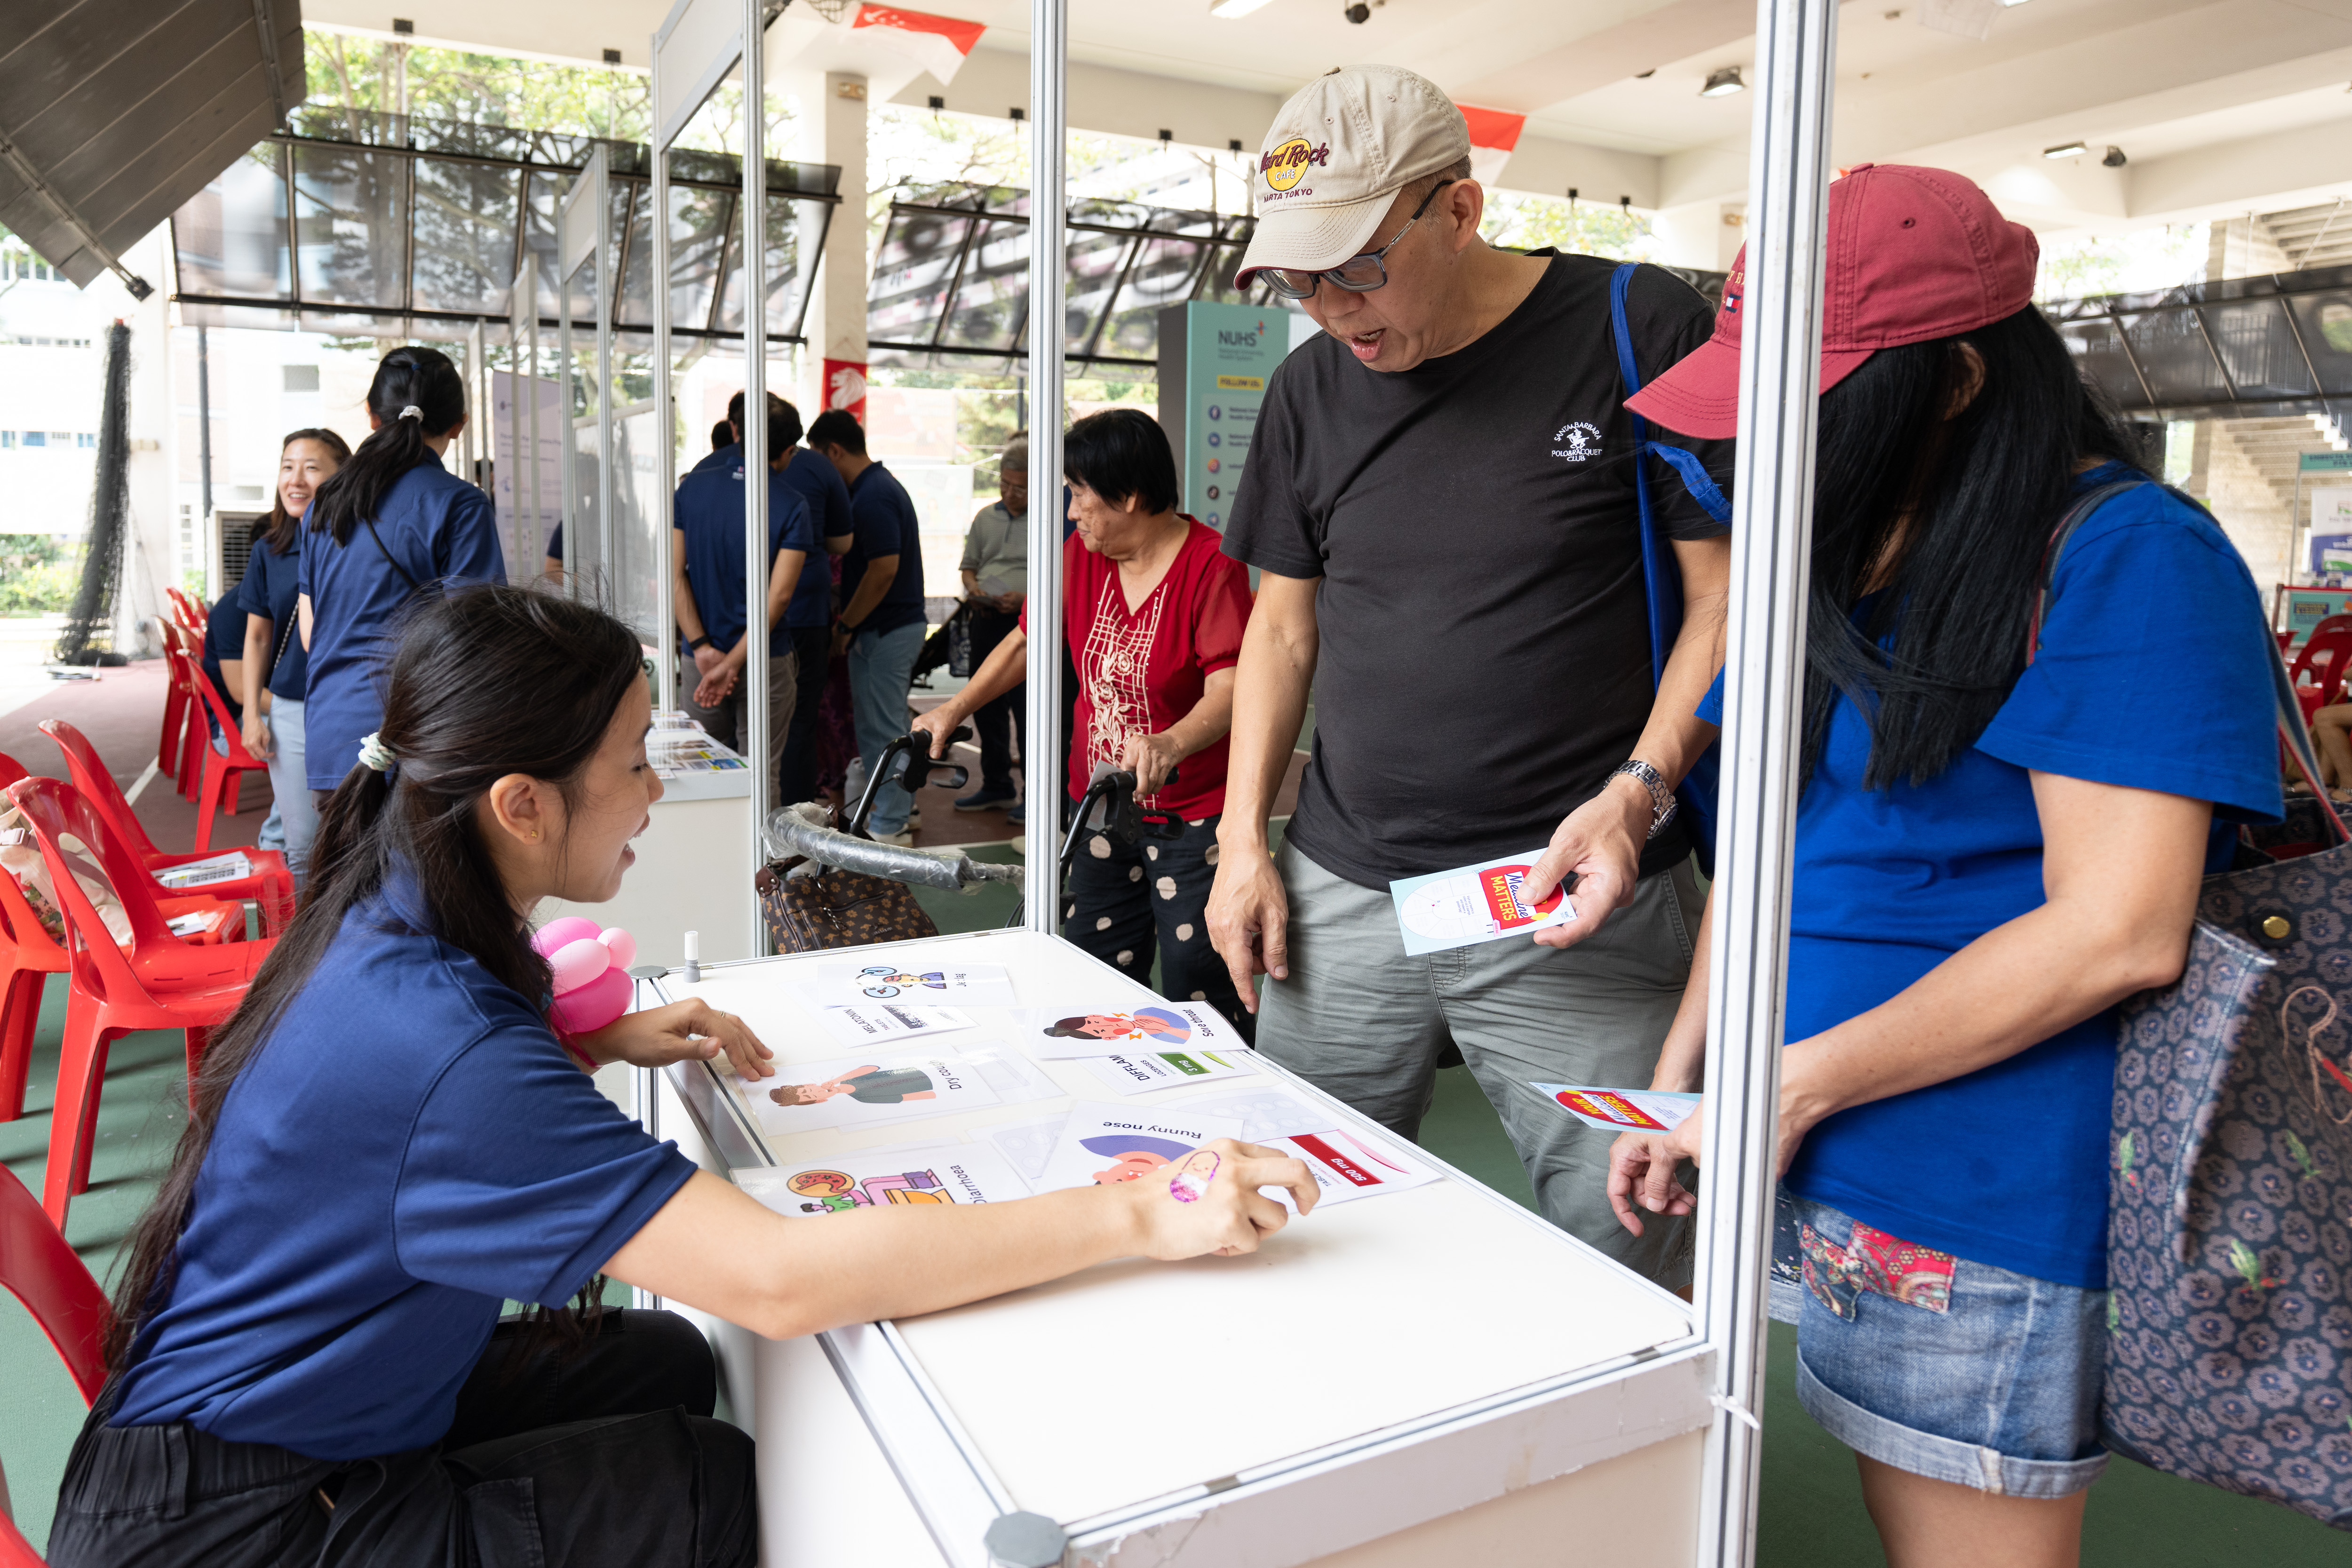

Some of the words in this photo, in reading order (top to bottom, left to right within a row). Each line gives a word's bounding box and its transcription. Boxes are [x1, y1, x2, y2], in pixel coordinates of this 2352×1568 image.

[1260, 146, 1290, 174] Hard
[1286, 143, 1329, 167] Rock
[1275, 169, 1295, 181] CAFE
[1264, 193, 1282, 203] NARITA
[1285, 188, 1312, 198] TOKYO
[1218, 330, 1257, 347] NUHS
[1554, 424, 1573, 441] SANTA
[1574, 422, 1602, 440] BARBARA
[1491, 876, 1517, 921] MATTERS
[843, 1009, 877, 1034] MELATONIN
[1182, 1010, 1203, 1023] throat
[874, 1019, 890, 1030] TABLETS
[1198, 1024, 1214, 1037] Sore
[928, 1060, 951, 1076] cough
[1140, 1060, 1167, 1077] LOZENGES
[1178, 1060, 1191, 1068] mg
[945, 1078, 962, 1090] Dry
[1572, 1098, 1604, 1114] YOUR
[1588, 1094, 1636, 1123] Medicine
[1600, 1095, 1652, 1125] MATTERS
[1147, 1125, 1201, 1139] Runny
[1331, 1158, 1350, 1169] mg
[1345, 1170, 1367, 1182] 500
